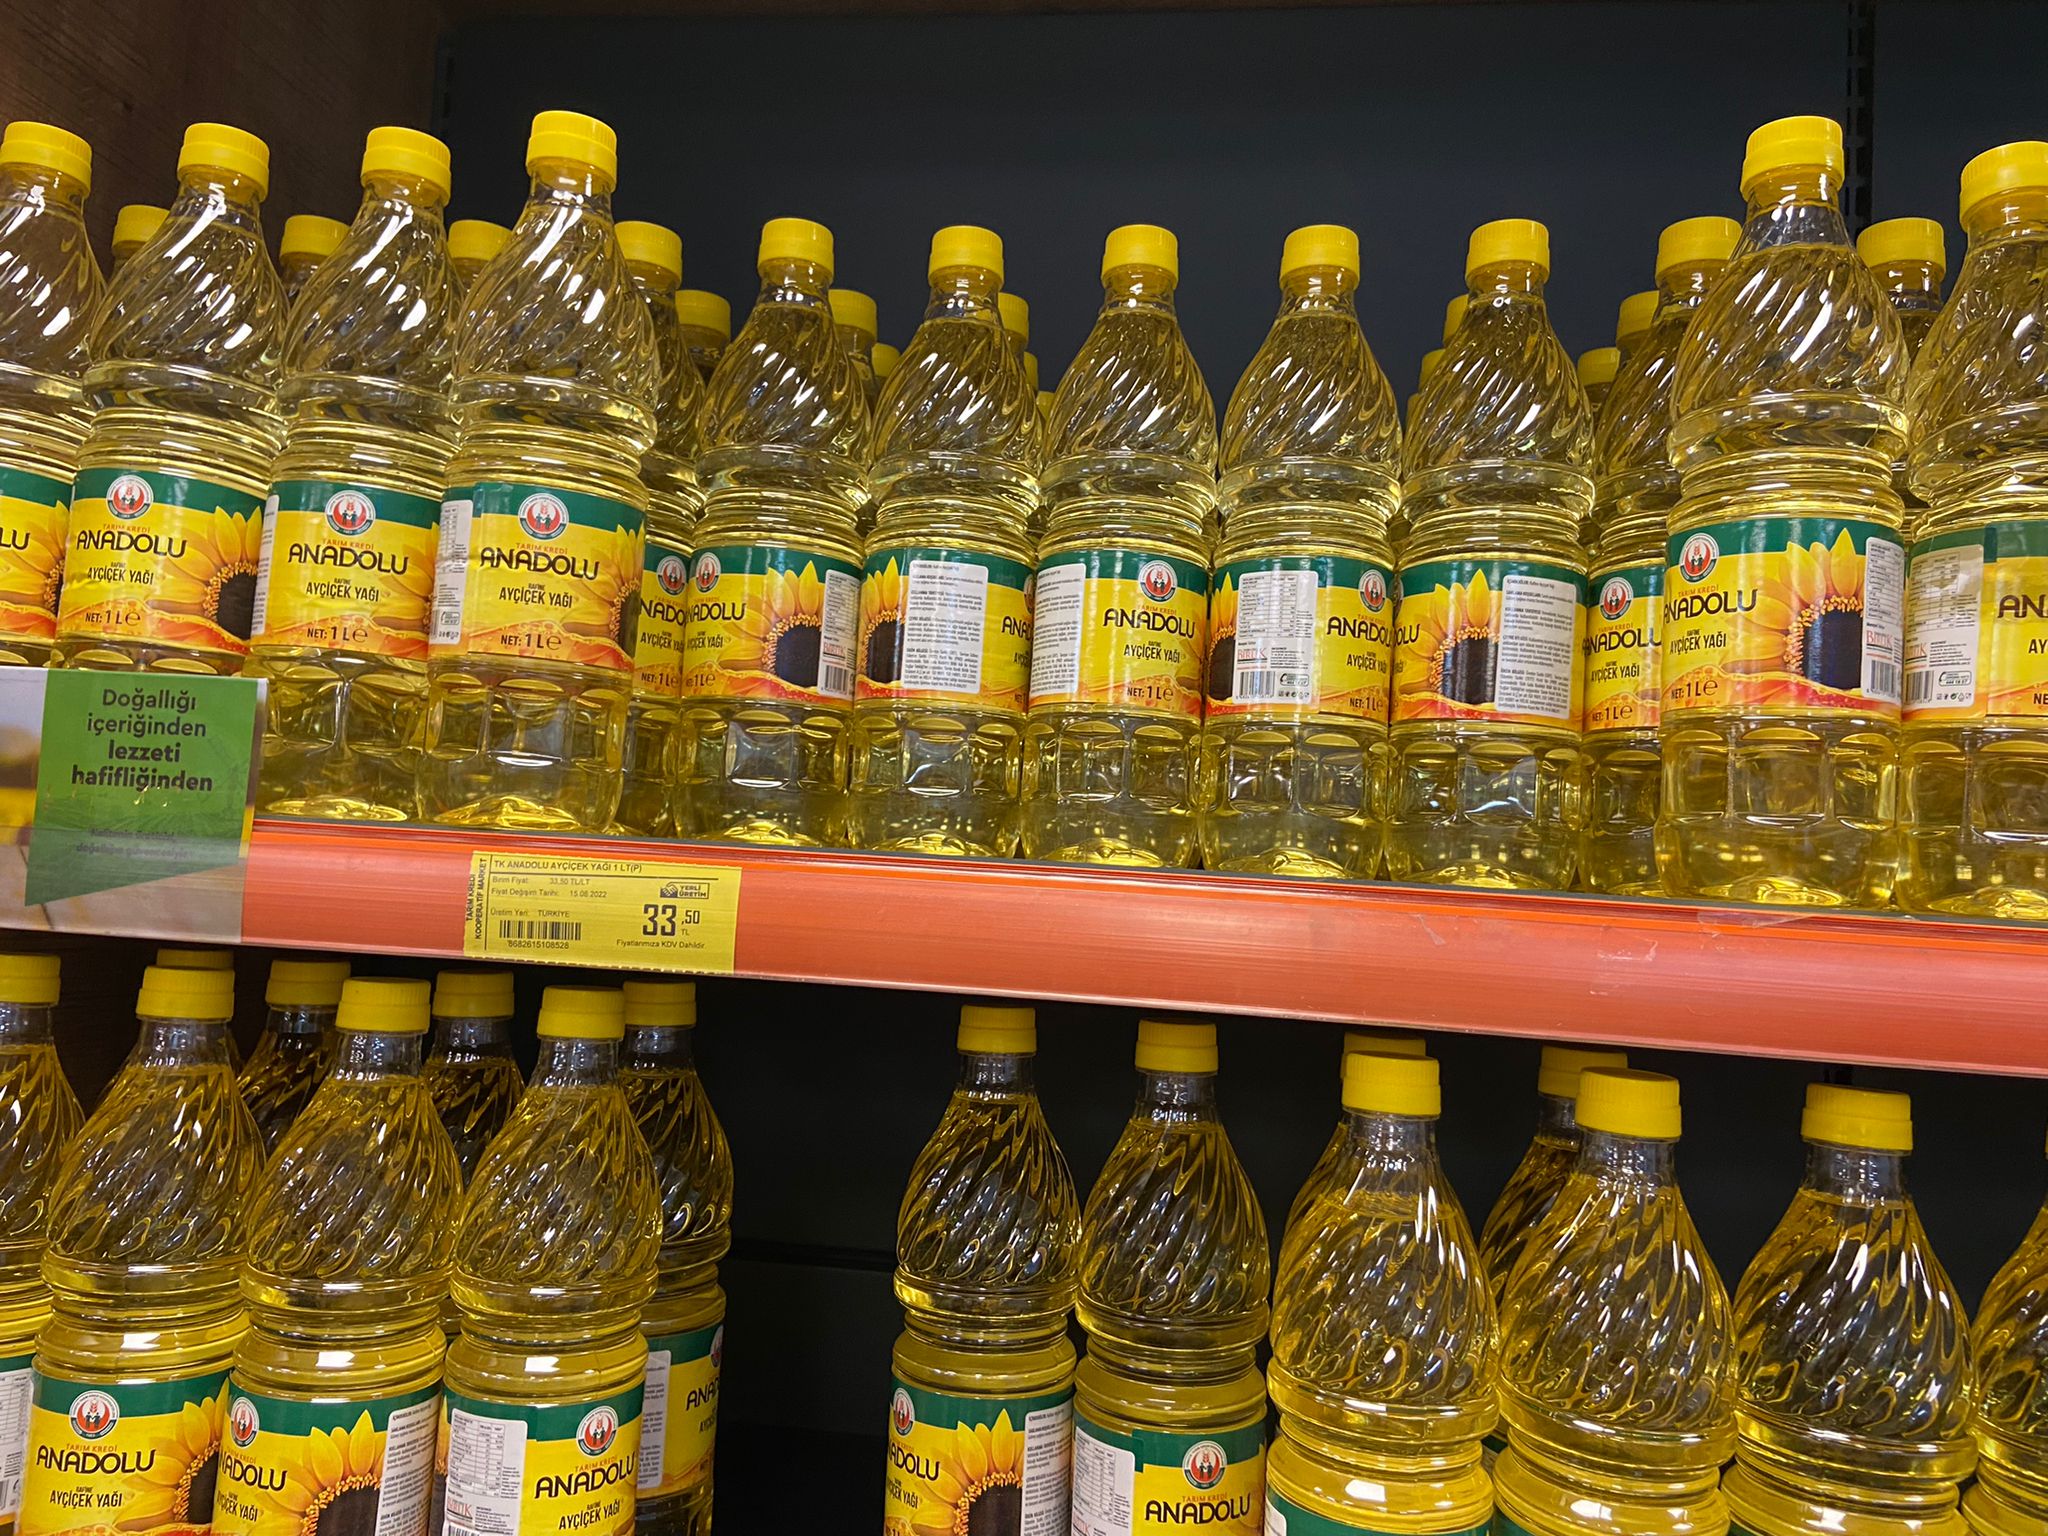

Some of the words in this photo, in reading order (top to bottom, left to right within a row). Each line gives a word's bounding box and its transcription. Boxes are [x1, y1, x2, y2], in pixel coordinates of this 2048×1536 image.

[76, 529, 188, 558] ANADOLU
[288, 543, 409, 575] ANADOLU
[480, 547, 600, 580] ANADOLU
[87, 565, 126, 583] AYÇİÇEK
[129, 570, 154, 585] YAĞI
[306, 581, 351, 600] AYÇİÇEK
[354, 587, 380, 602] YAĞI
[499, 587, 545, 605] AYÇİÇEK
[549, 592, 573, 608] YAĞI
[85, 612, 103, 623] NET:
[640, 598, 686, 626] NADO
[1664, 588, 1758, 624] ANADOLU
[1997, 594, 2048, 618] AN
[307, 628, 327, 640] NET:
[1001, 615, 1031, 640] ANAD
[1102, 608, 1195, 638] ANADOLU
[500, 635, 521, 646] NET:
[1669, 635, 1701, 655] AYÇİÇEK
[1703, 631, 1727, 649] YAĞI
[1123, 644, 1162, 660] AYÇİÇEK
[1164, 649, 1181, 663] YAĞI
[1619, 662, 1640, 678] YAĞI
[102, 687, 196, 714] Doğallığı
[1127, 687, 1145, 698] NET:
[87, 712, 206, 738] içeriğinden
[108, 739, 182, 763] lezzeti
[71, 764, 213, 792] hafifliğinden
[478, 858, 487, 890] MARKET
[494, 860, 505, 868] TK
[507, 861, 549, 869] ANADOLU
[551, 861, 589, 871] AYÇİÇEK
[591, 862, 611, 871] YAĞI
[620, 864, 642, 873] LT(P)
[491, 888, 508, 896] Fiyat
[465, 899, 474, 921] TARIM
[642, 903, 677, 936] 33
[66, 1443, 91, 1451] TARIM
[36, 1445, 156, 1474] ANADOLU
[534, 1451, 635, 1499] ANADOLU
[49, 1490, 93, 1509] AYÇİÇEK
[97, 1491, 123, 1508] YAĞI
[1145, 1492, 1251, 1524] ANADOLU
[239, 1504, 258, 1522] YAĞI
[558, 1508, 601, 1530] AYÇİÇEK
[603, 1498, 620, 1519] YAĞI
